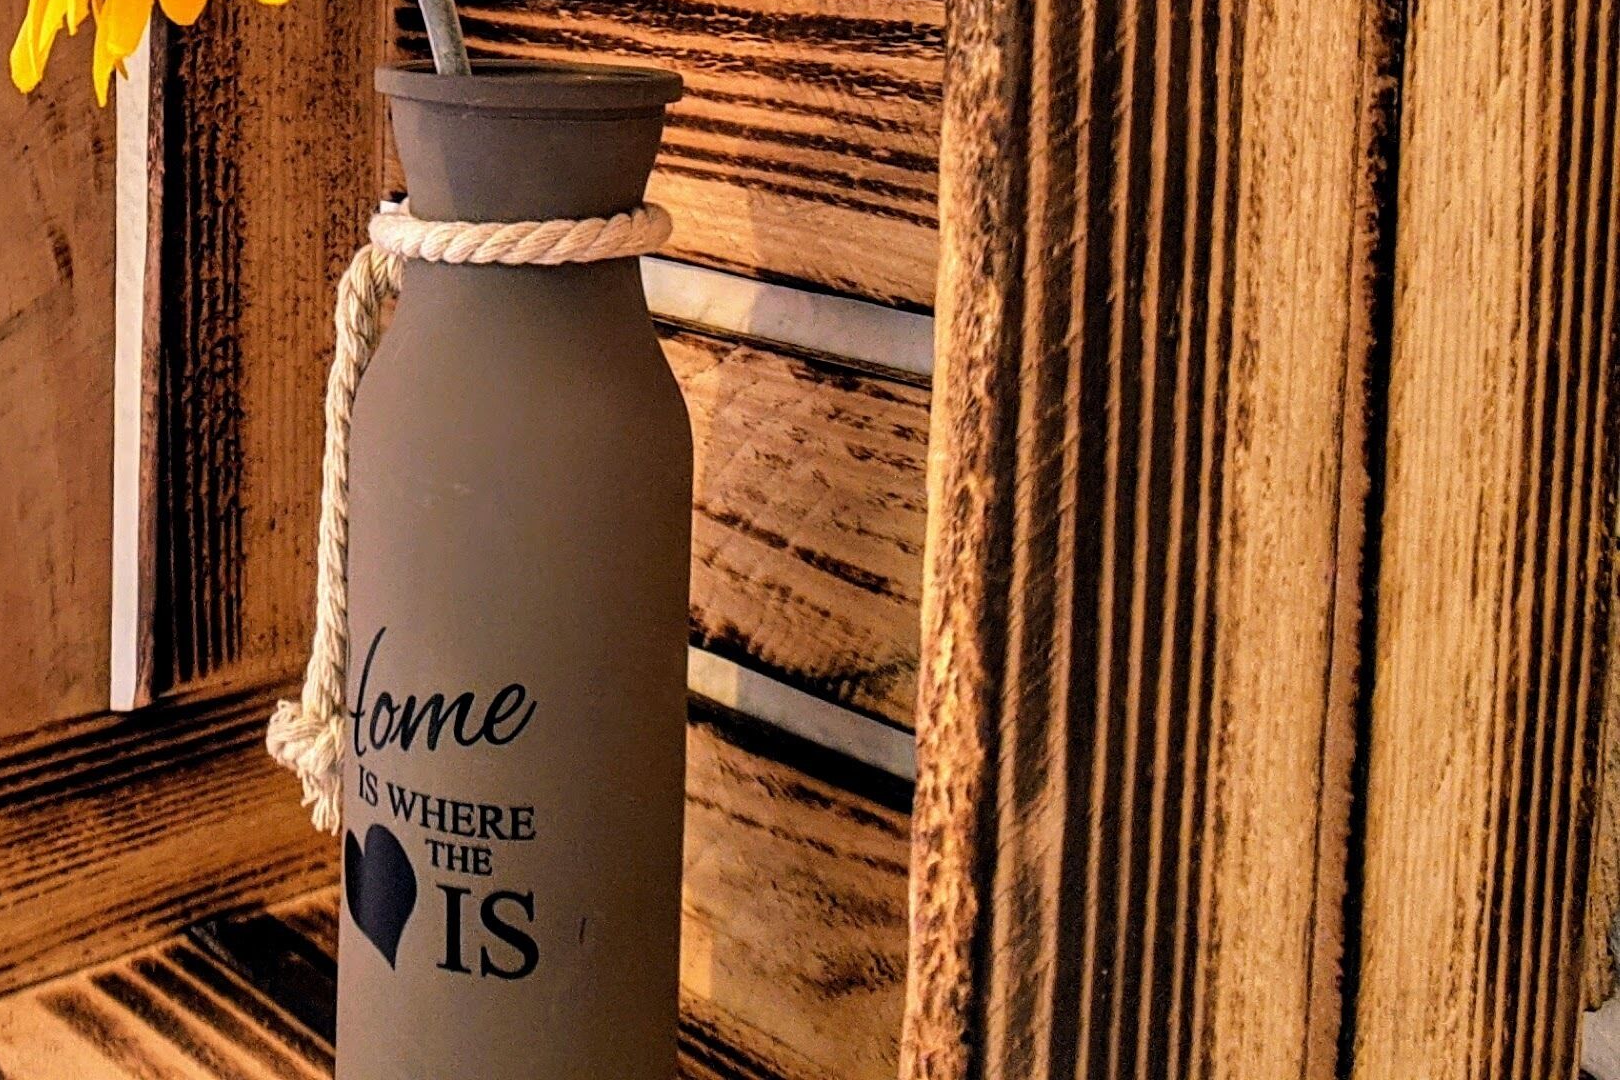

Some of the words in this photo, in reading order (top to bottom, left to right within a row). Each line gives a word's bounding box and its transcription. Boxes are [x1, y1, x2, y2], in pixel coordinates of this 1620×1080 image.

[358, 764, 379, 808] IS
[386, 781, 537, 841] WHERE
[424, 838, 494, 877] THE
[435, 883, 540, 981] IS
